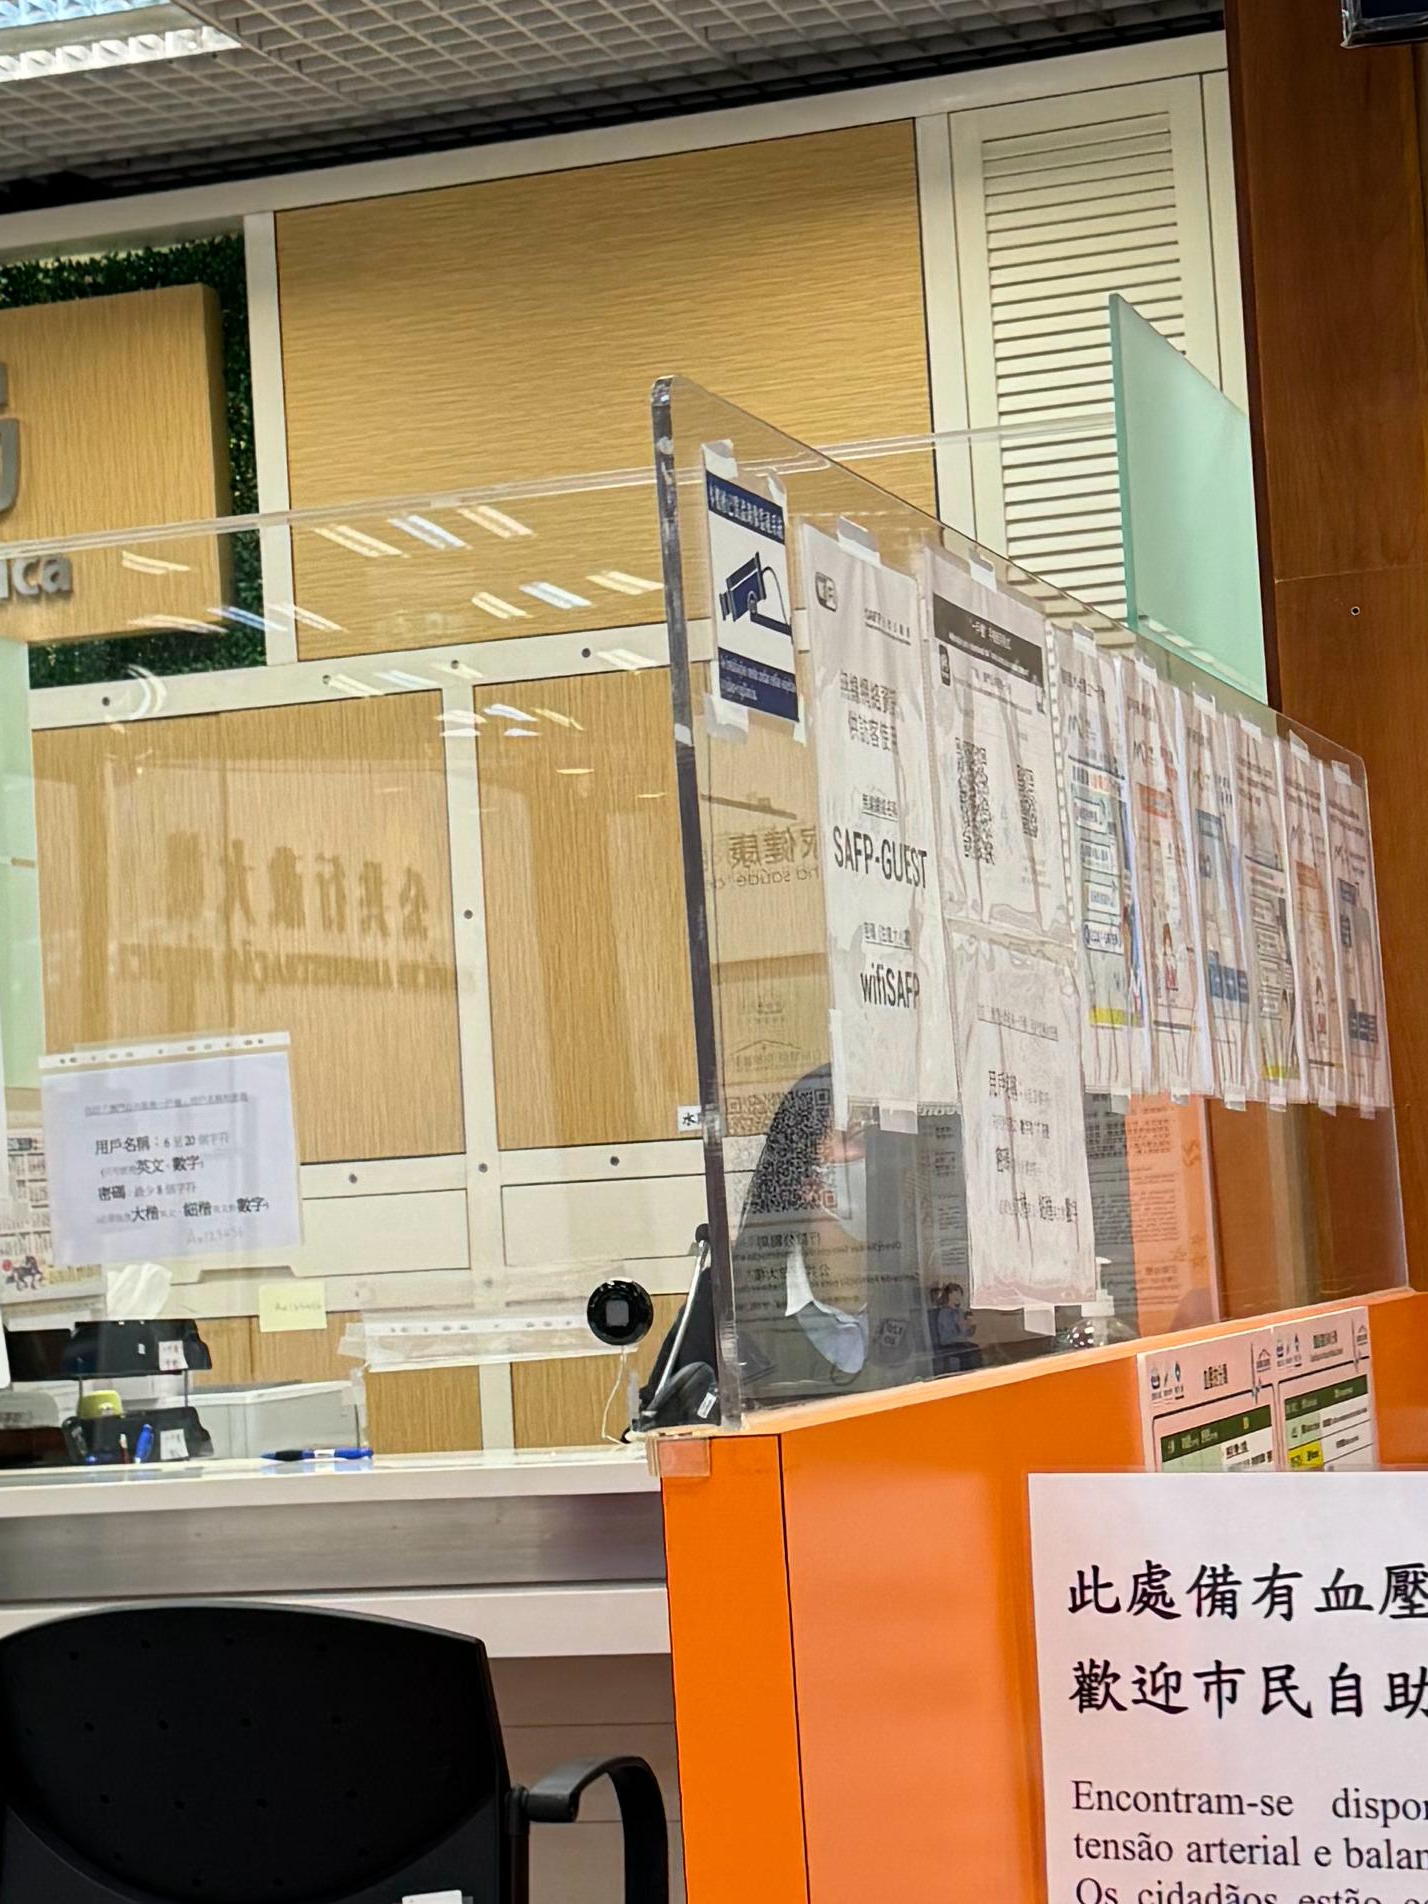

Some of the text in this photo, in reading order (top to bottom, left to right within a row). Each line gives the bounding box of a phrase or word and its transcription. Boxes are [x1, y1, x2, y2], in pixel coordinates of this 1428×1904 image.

[832, 825, 928, 889] SAFP-GUEST
[860, 962, 920, 1010] wifiSAFP
[1072, 1781, 1293, 1816] Encontram-se
[1074, 1832, 1173, 1862] tensão
[1187, 1835, 1300, 1866] arterial
[1314, 1846, 1331, 1867] e
